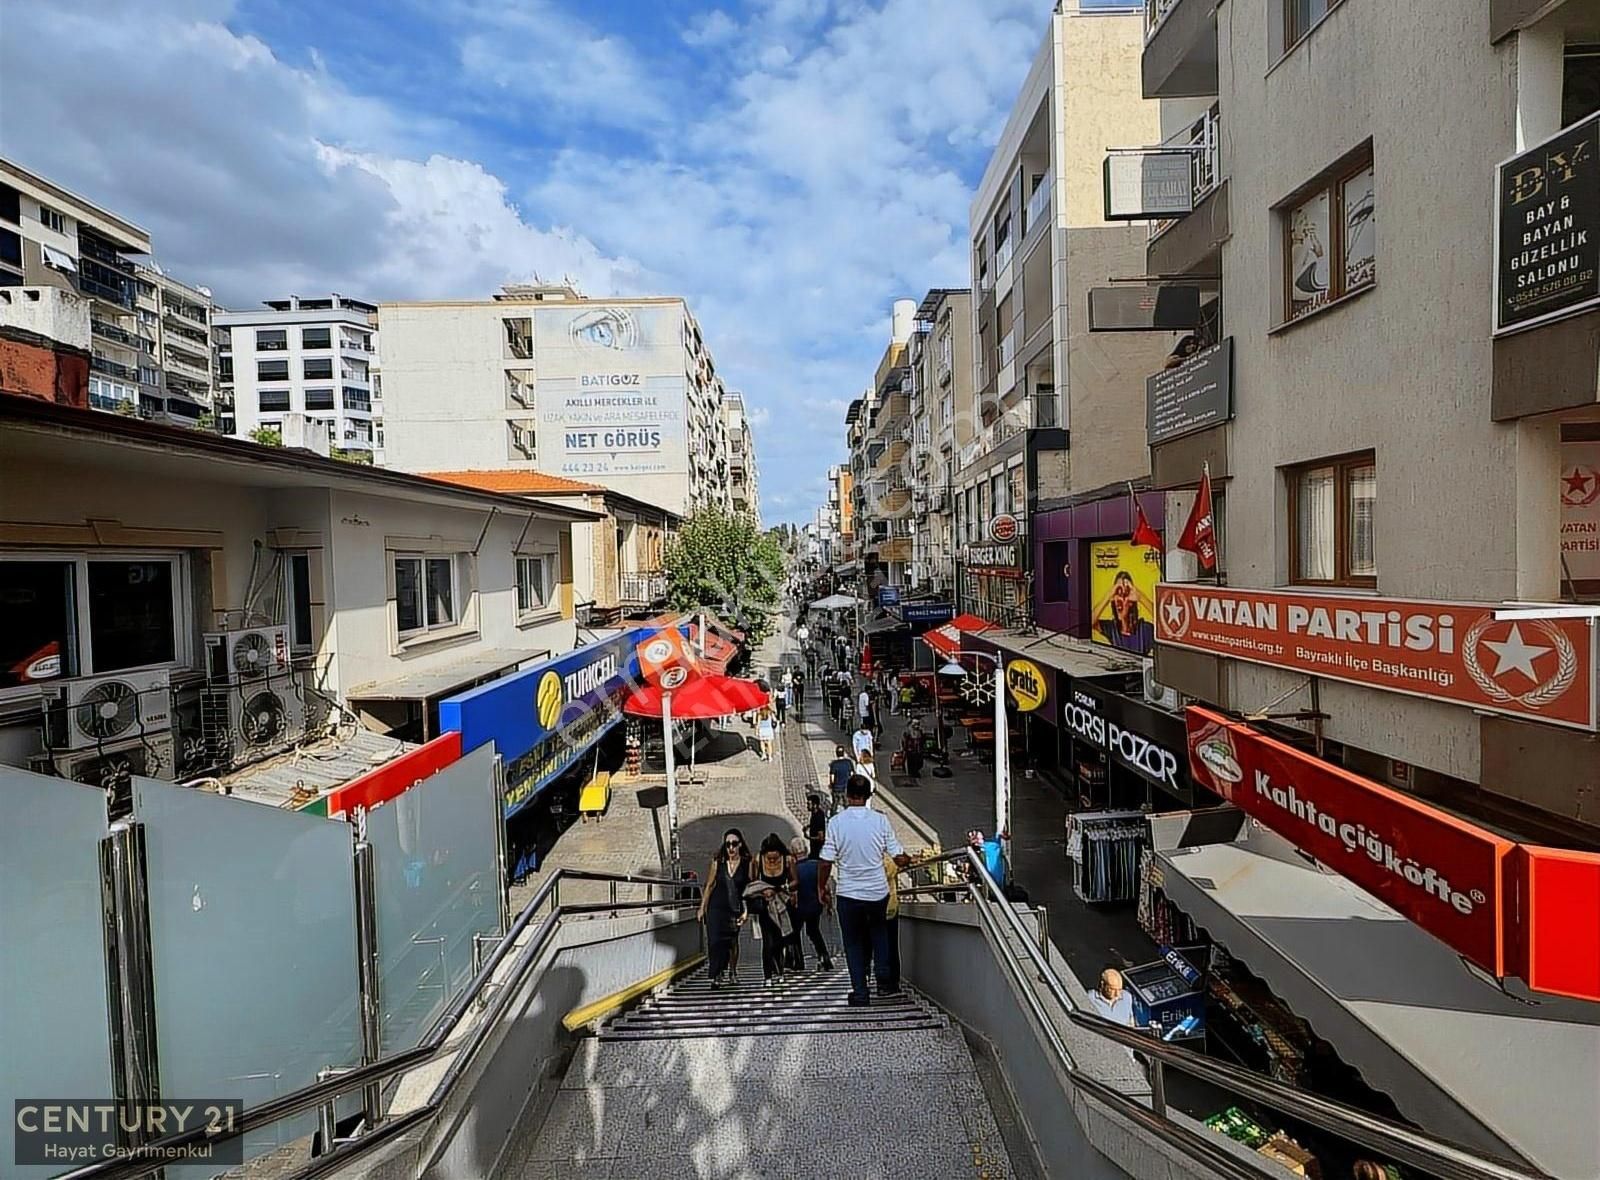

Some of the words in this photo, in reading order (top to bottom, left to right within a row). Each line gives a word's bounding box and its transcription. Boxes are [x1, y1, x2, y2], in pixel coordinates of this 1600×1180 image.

[1526, 200, 1555, 225] BAY
[1561, 195, 1570, 210] &
[1523, 214, 1573, 246] BAYAN
[1511, 230, 1588, 270] GÜZELLİK
[1517, 255, 1579, 288] SALONU
[565, 399, 592, 407] AKILLI
[594, 398, 642, 407] MERCEKLER
[565, 433, 598, 448] NET
[604, 429, 661, 448] GÖRÜŞ
[562, 463, 580, 472] 444
[583, 463, 594, 472] 23
[598, 462, 609, 472] 24
[1192, 597, 1278, 631] VATAN
[1192, 631, 1284, 656] www.vatanpartisi.org.tr
[1296, 647, 1342, 666] Bayraklı
[1346, 651, 1368, 671] İlçe
[1372, 659, 1454, 686] Başkanlığı
[564, 654, 618, 704] TURKCELL
[1010, 668, 1038, 697] gratis
[1074, 691, 1096, 710] FORUM
